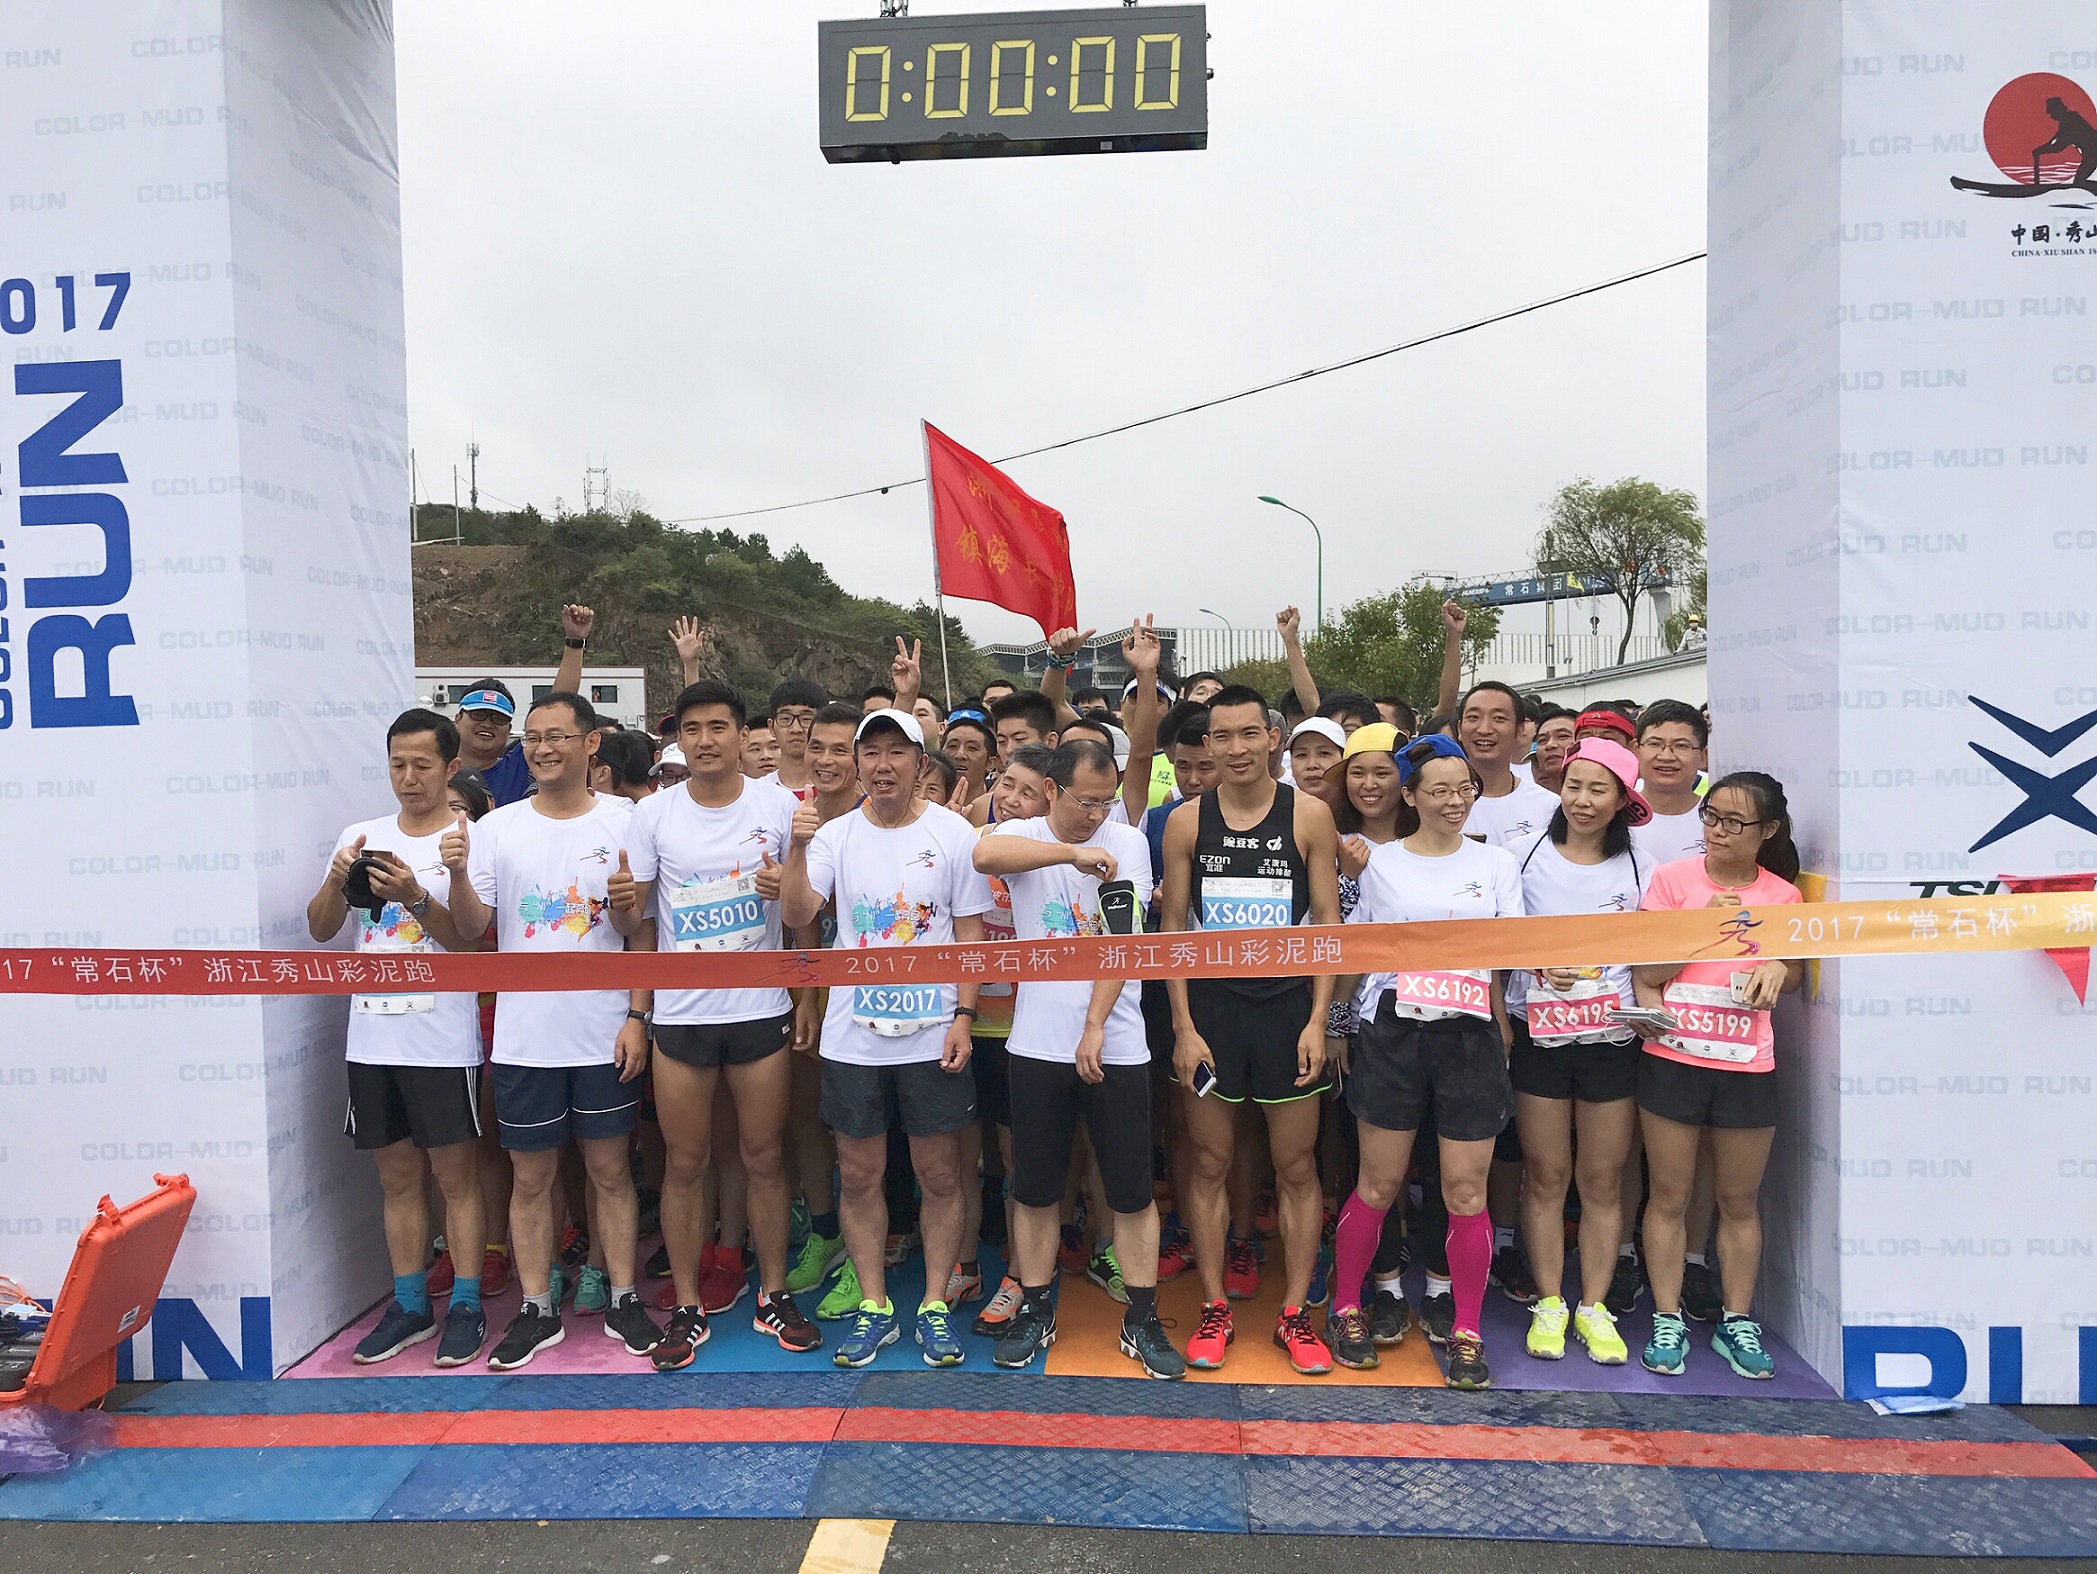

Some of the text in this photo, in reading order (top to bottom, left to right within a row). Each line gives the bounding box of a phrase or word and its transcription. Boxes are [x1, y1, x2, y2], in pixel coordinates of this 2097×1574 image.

[5, 48, 61, 69] RUN
[1899, 54, 1965, 74] RUN
[845, 33, 1181, 122] 0:00:00
[35, 107, 204, 136] COLOR-MUD
[9, 192, 67, 212] RUN
[1899, 219, 1967, 240] RUN
[0, 269, 131, 334] 017
[2019, 297, 2087, 316] RUN
[1900, 369, 1967, 388] RUN
[233, 400, 266, 427] RUN
[2020, 446, 2087, 466] RUN
[152, 476, 284, 504] COLOR-MUD
[15, 359, 141, 728] RUN
[1901, 534, 1968, 553] RUN
[239, 554, 273, 576] RUN
[1826, 610, 2089, 636] COLOR-MUD RUN
[159, 629, 325, 652] COLOR-MUD RUN
[247, 700, 279, 718] RUN
[1902, 688, 1968, 708] RUN
[37, 780, 95, 798] RUN
[166, 769, 330, 795] COLOR-MUD RUN
[68, 848, 285, 876] COLOR-MUD RUN
[1904, 851, 1970, 871] RUN
[678, 900, 758, 934] XS5010
[1205, 901, 1288, 926] XS6020
[1788, 916, 1864, 943] 2017
[1886, 905, 2037, 941] “常石杯”
[44, 930, 102, 948] RUN
[846, 936, 1344, 975] 2017 “常石杯” 浙江秀山彩泥跑
[51, 956, 183, 983] “常石杯”
[203, 957, 436, 984] 浙江秀山彩泥跑
[857, 987, 936, 1013] XS2017
[1402, 974, 1486, 1007] XS6192
[1905, 997, 1971, 1016] RUN
[50, 1065, 107, 1084] RUN
[2024, 1075, 2092, 1096] RUN
[81, 1140, 253, 1162] COLOR-MUD
[1907, 1159, 1973, 1179] RUN
[2026, 1237, 2093, 1257] RUN
